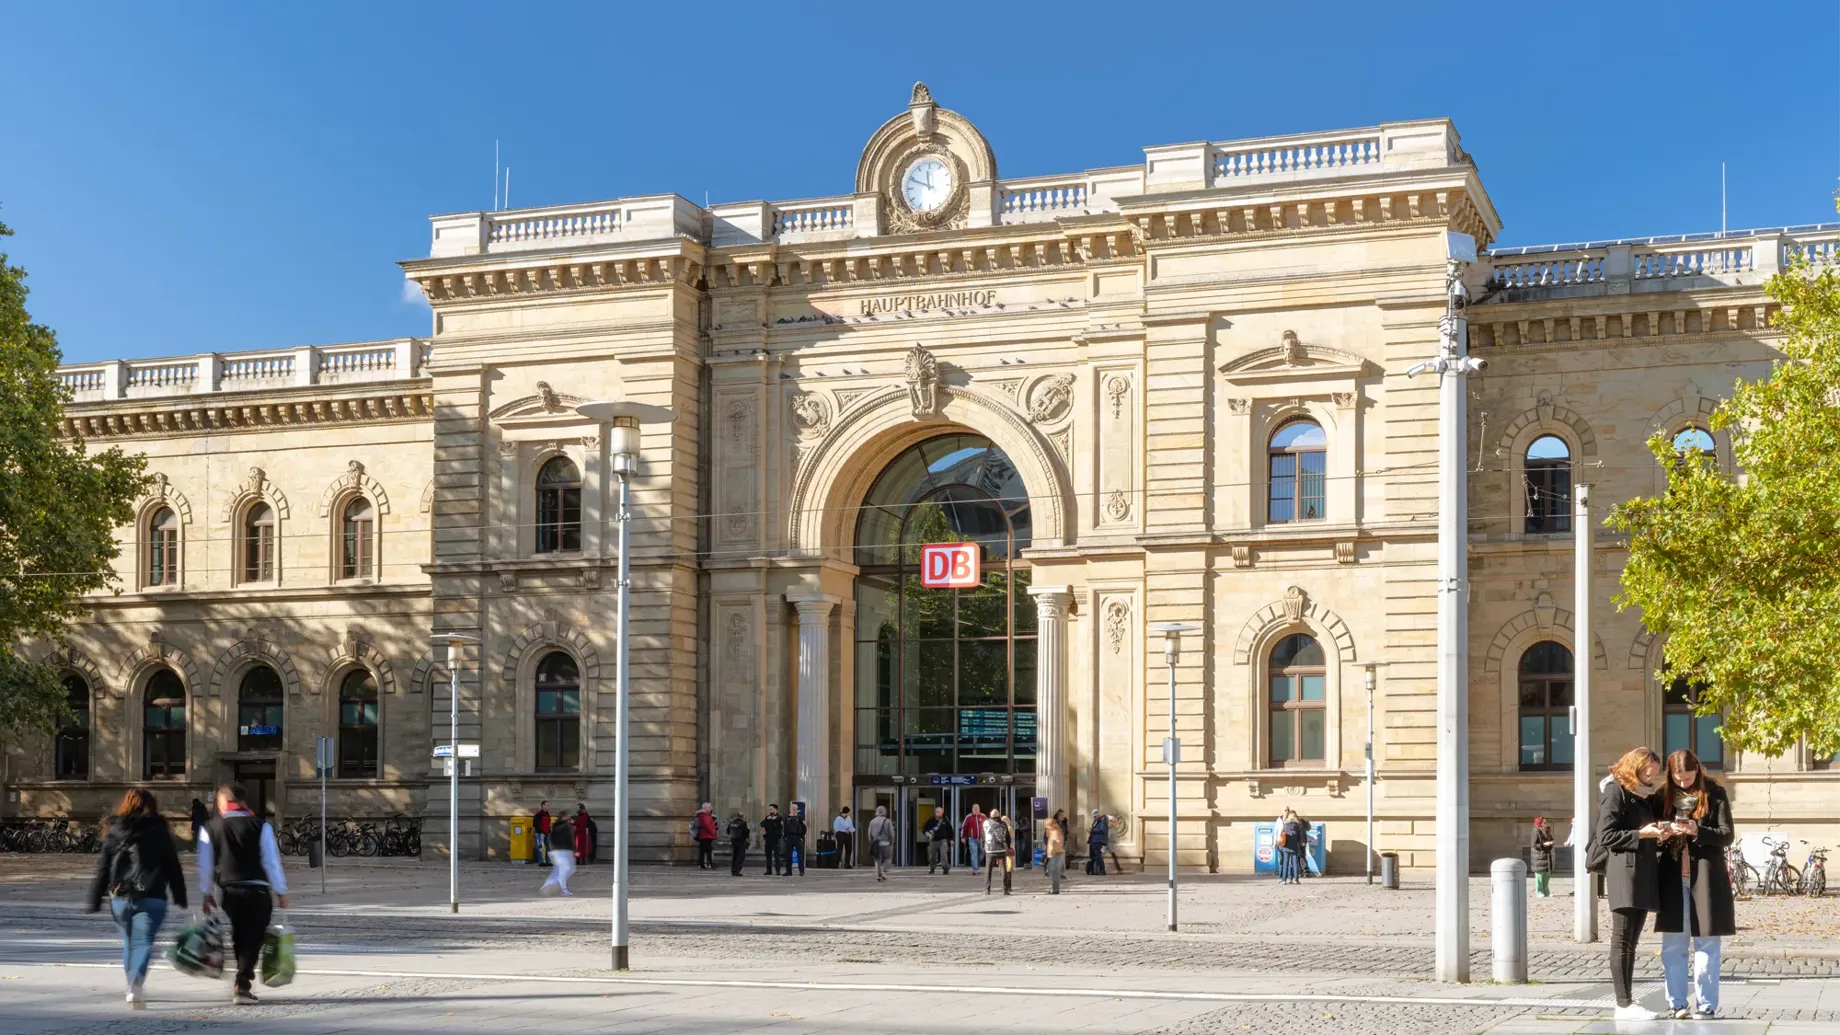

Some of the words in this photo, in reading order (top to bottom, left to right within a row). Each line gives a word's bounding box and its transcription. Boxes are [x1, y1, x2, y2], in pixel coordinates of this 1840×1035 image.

[860, 290, 996, 314] HAUPTBAHNHOF
[929, 551, 970, 580] DB
[249, 726, 277, 735] ALDI
